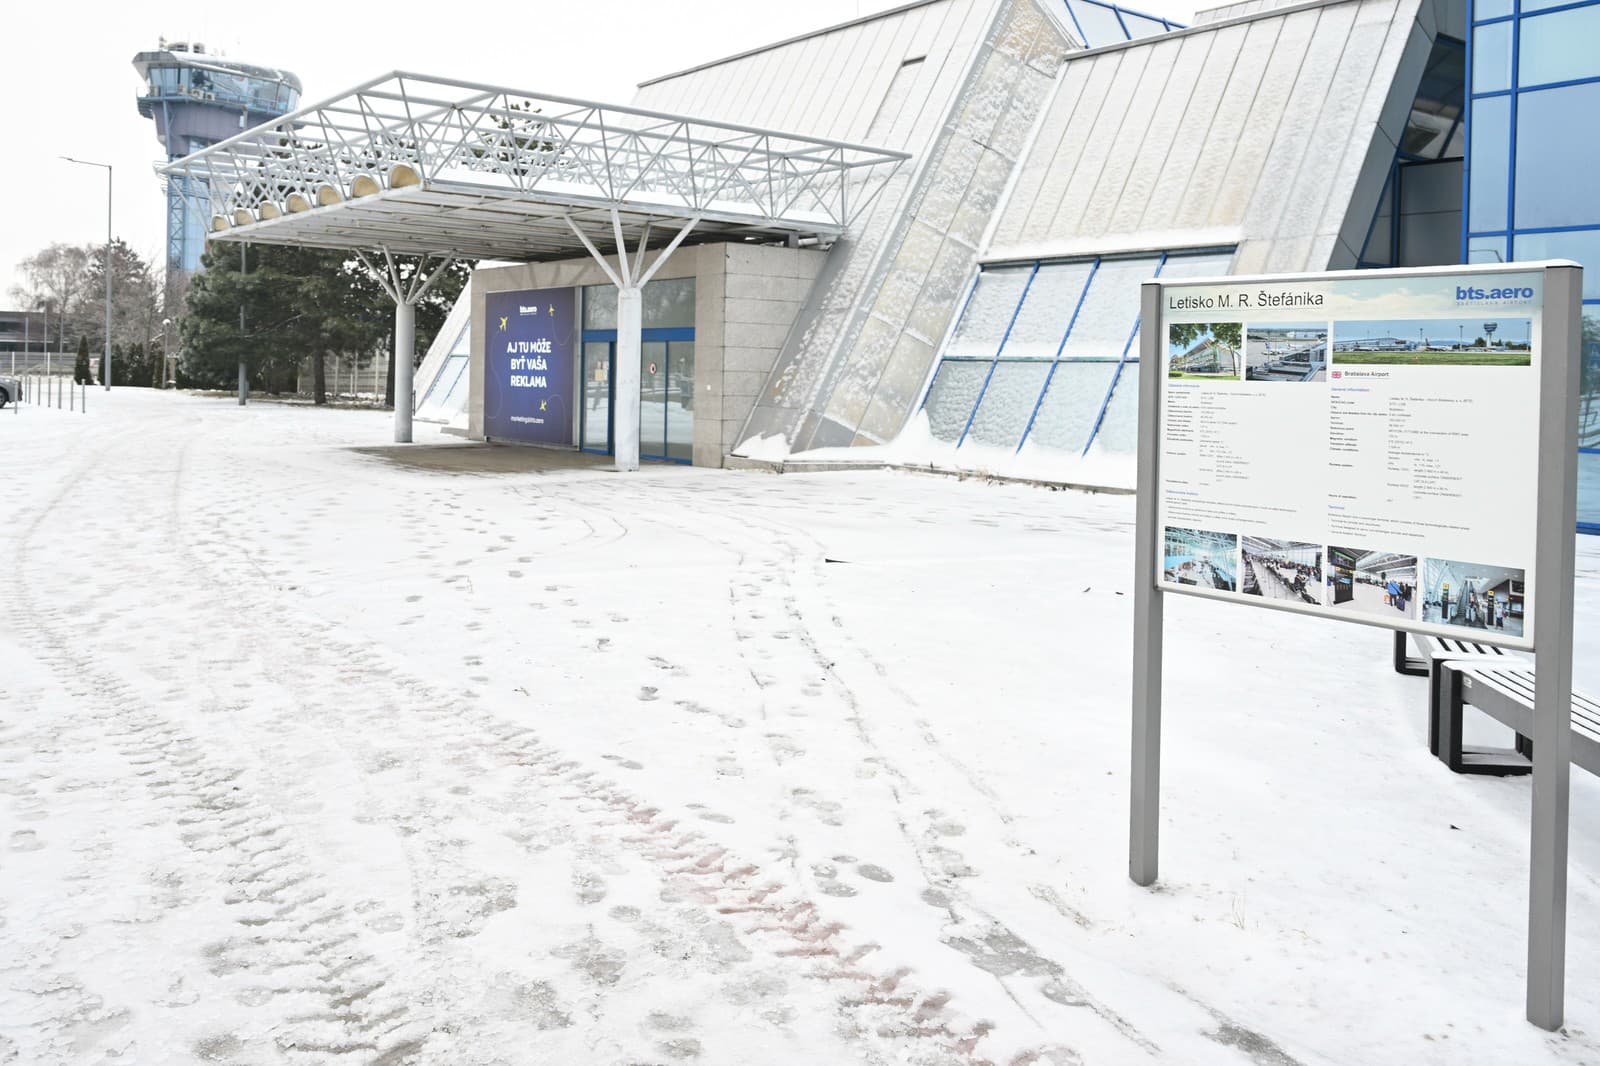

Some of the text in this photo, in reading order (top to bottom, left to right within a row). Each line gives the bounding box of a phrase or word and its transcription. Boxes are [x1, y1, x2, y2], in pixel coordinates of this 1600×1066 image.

[1169, 290, 1324, 310] Letisko M. R. Štefánika
[1456, 286, 1534, 300] bts.aero
[507, 342, 517, 353] AJ
[519, 342, 529, 353] TU
[527, 355, 547, 371] VAŠA
[511, 376, 547, 388] REKLAMA
